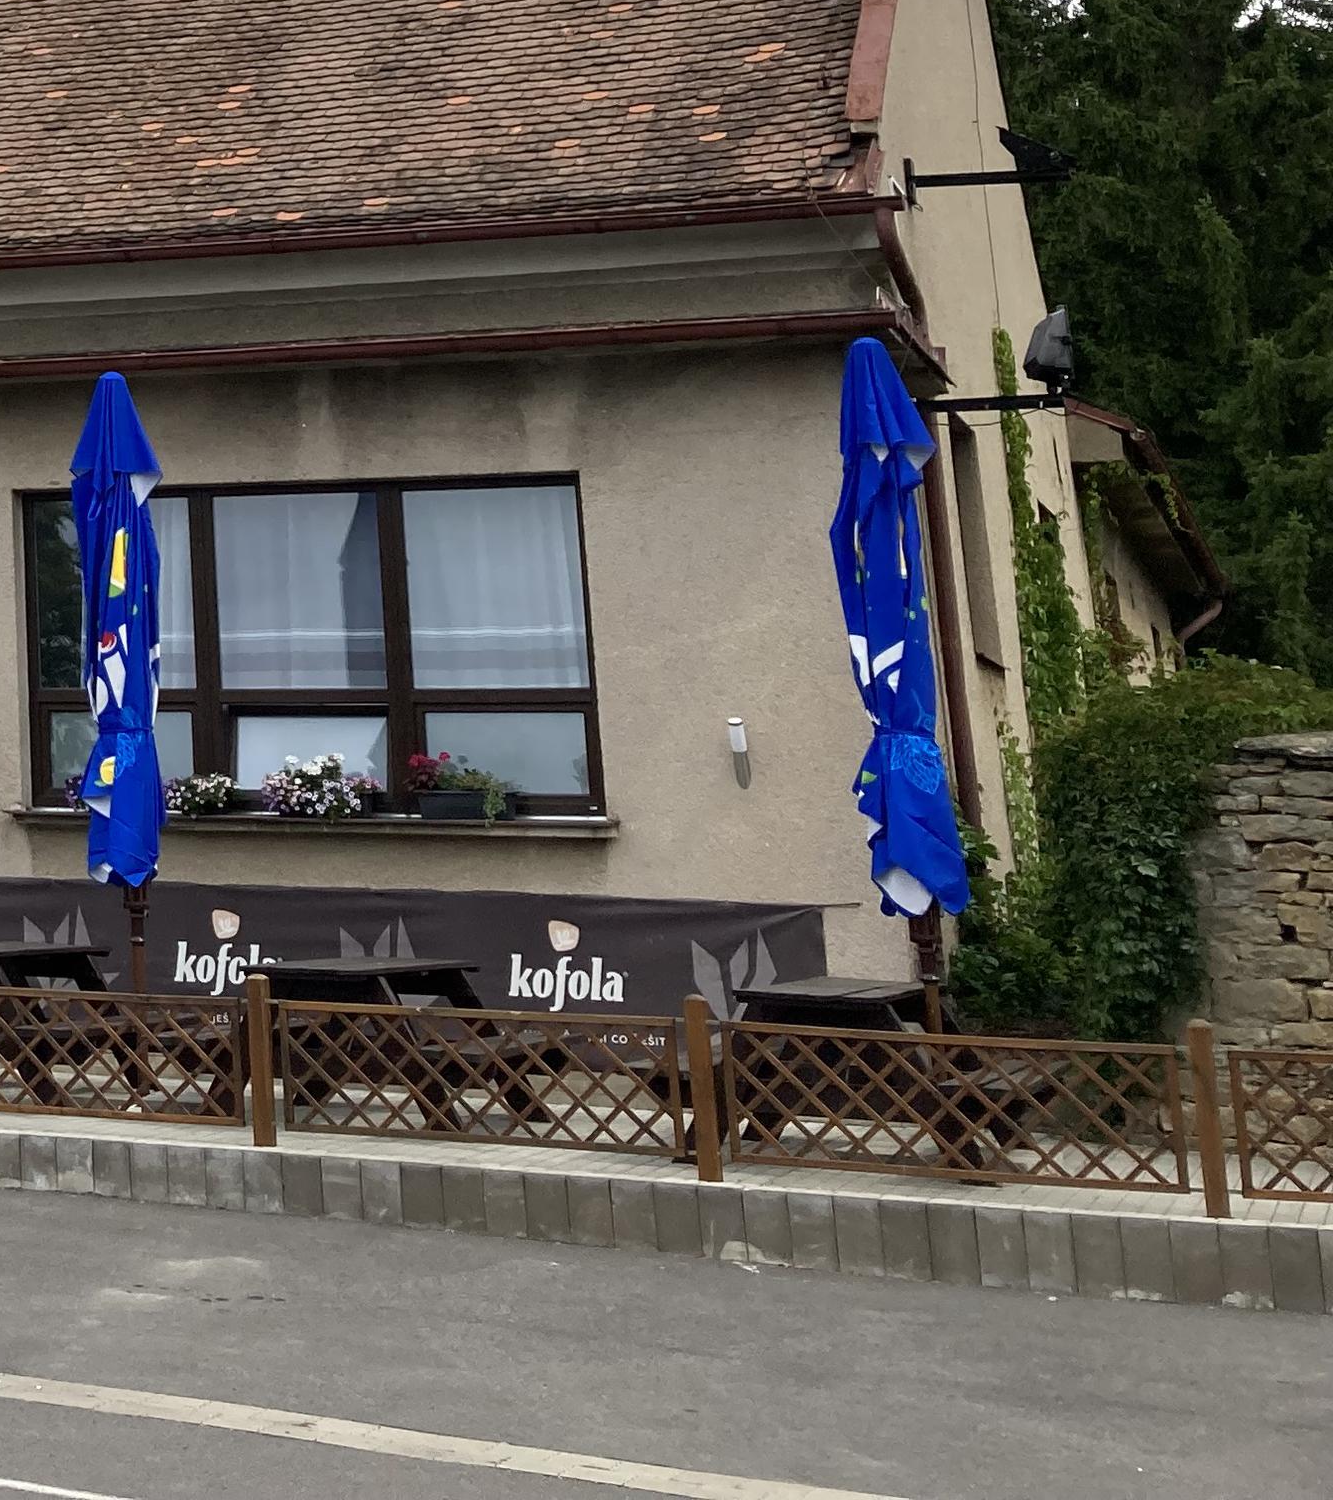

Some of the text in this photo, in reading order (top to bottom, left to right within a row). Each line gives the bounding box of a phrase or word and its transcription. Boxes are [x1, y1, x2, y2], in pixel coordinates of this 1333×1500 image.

[174, 940, 276, 996] kofol
[508, 953, 624, 1012] kofola
[611, 1034, 628, 1044] CO
